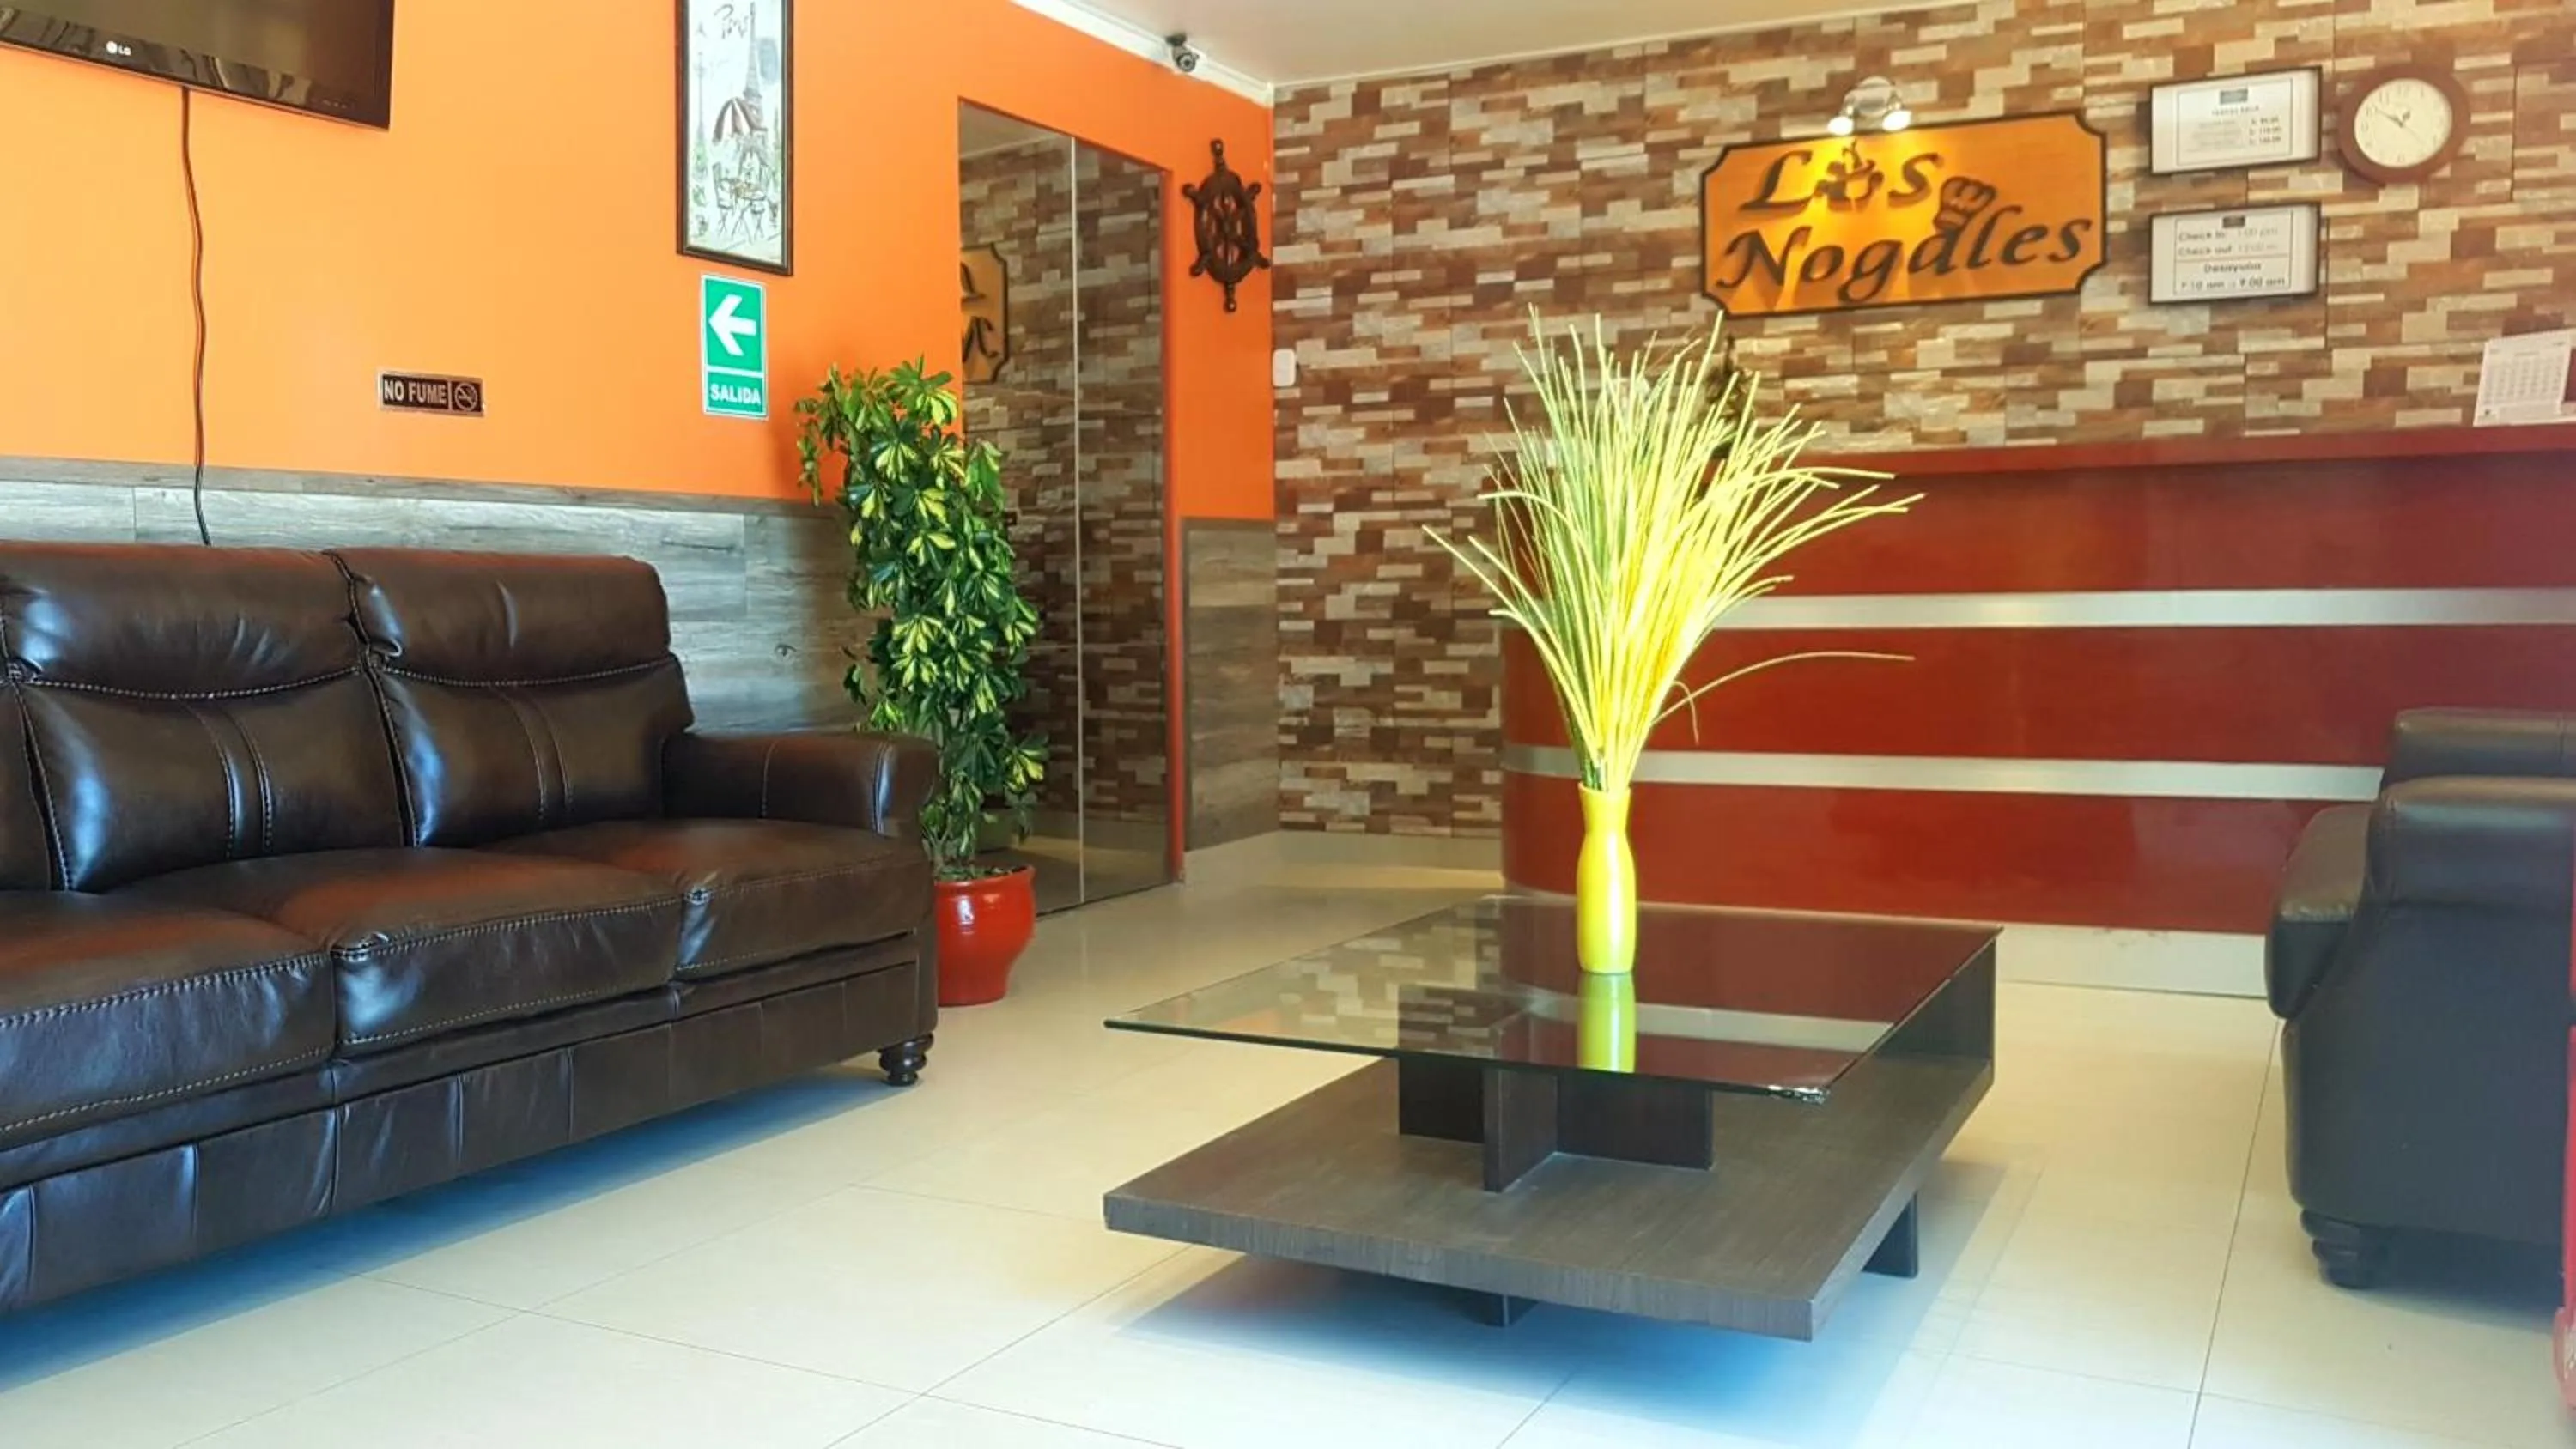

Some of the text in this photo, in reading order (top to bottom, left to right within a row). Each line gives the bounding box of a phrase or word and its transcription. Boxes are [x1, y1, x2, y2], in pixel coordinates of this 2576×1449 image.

[1715, 204, 2093, 305] Nogales
[384, 379, 447, 404] NO FUME
[710, 383, 762, 405] SALIDA
